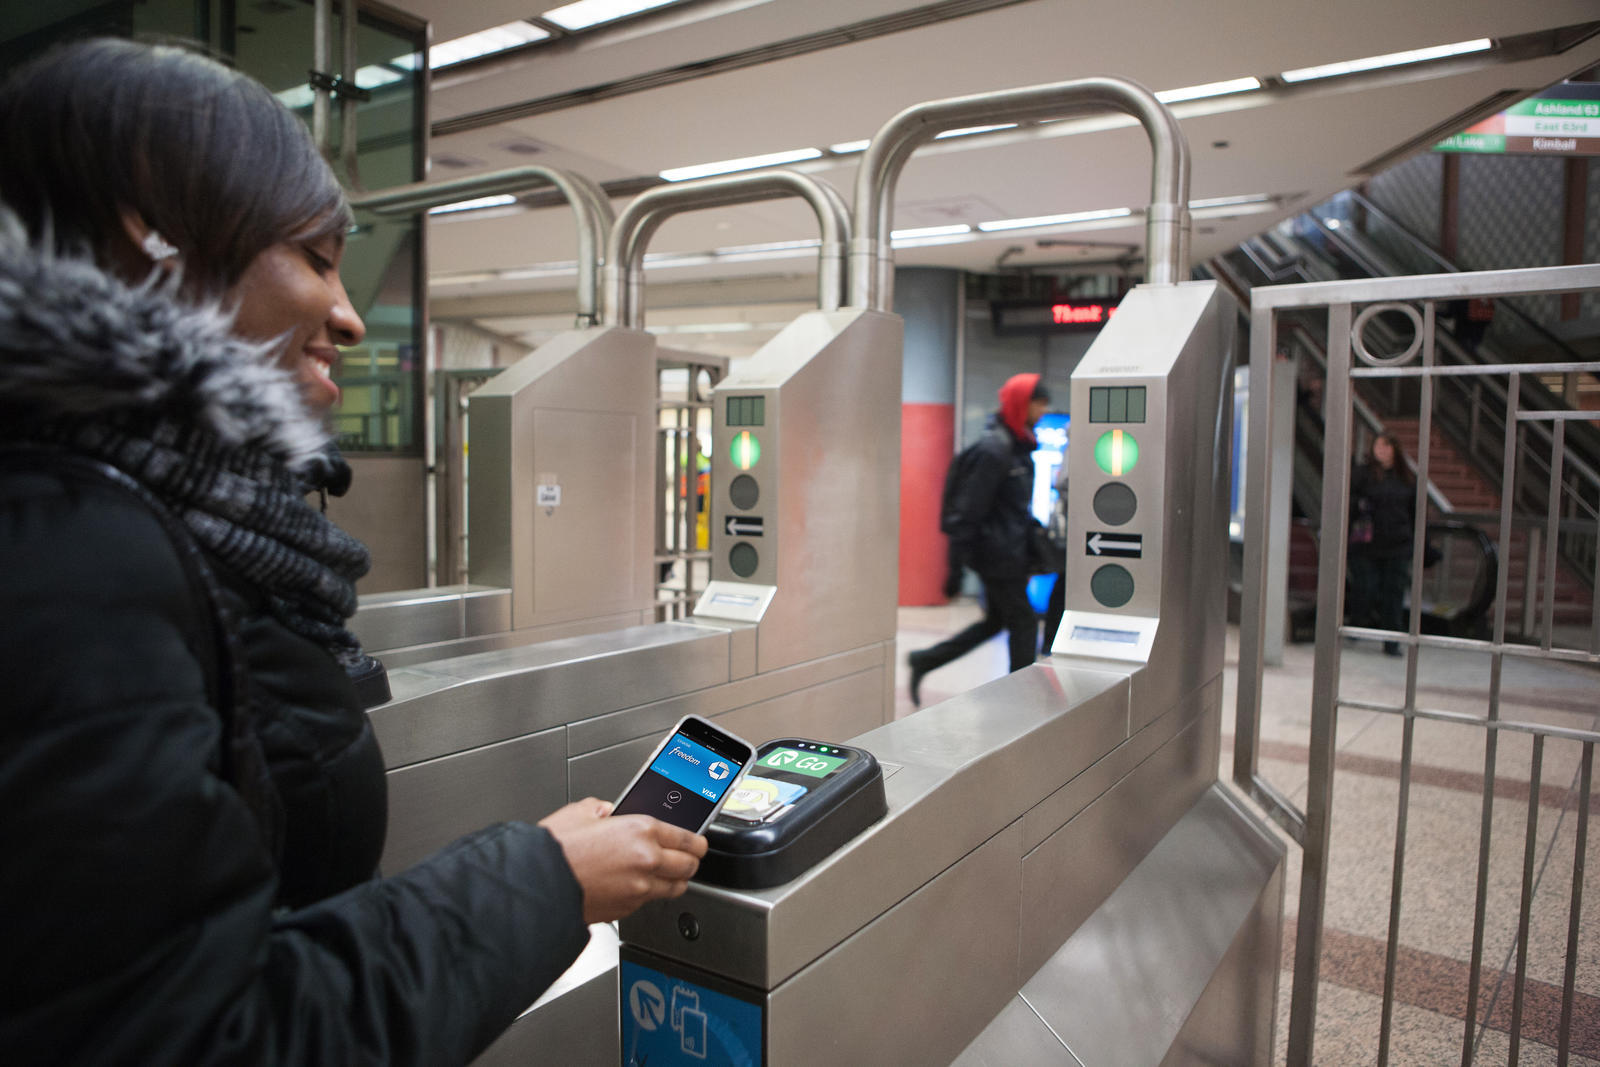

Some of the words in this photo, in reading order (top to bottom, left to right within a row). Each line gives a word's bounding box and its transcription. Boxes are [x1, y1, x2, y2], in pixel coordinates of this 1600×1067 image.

[1535, 121, 1559, 132] East
[1562, 121, 1588, 133] 63rd
[1533, 137, 1577, 151] Kimball
[1052, 304, 1102, 323] Thank
[668, 746, 701, 766] freedom
[795, 757, 828, 771] Go
[702, 787, 717, 800] VISA
